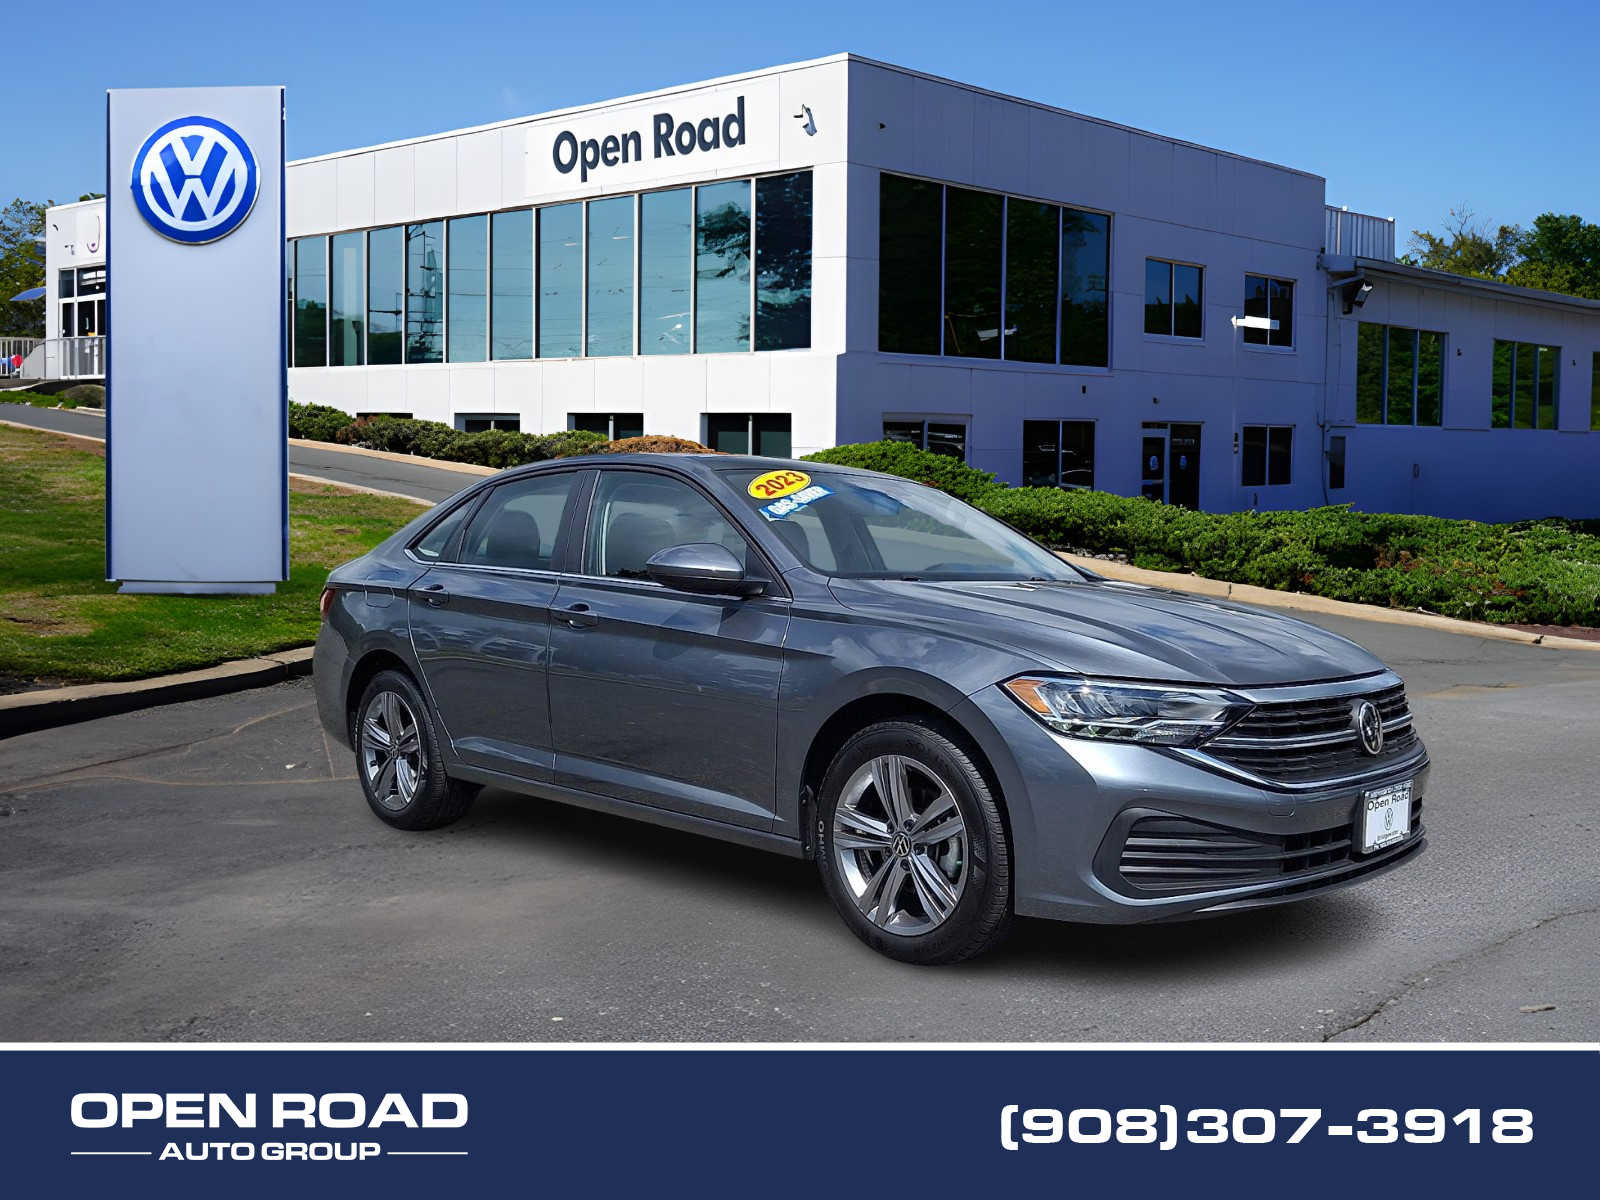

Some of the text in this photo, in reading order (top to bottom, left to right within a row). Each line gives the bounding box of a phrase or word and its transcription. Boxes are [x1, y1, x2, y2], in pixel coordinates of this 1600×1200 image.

[553, 95, 746, 183] Open Road
[756, 471, 805, 496] 2023
[1367, 798, 1390, 812] Open
